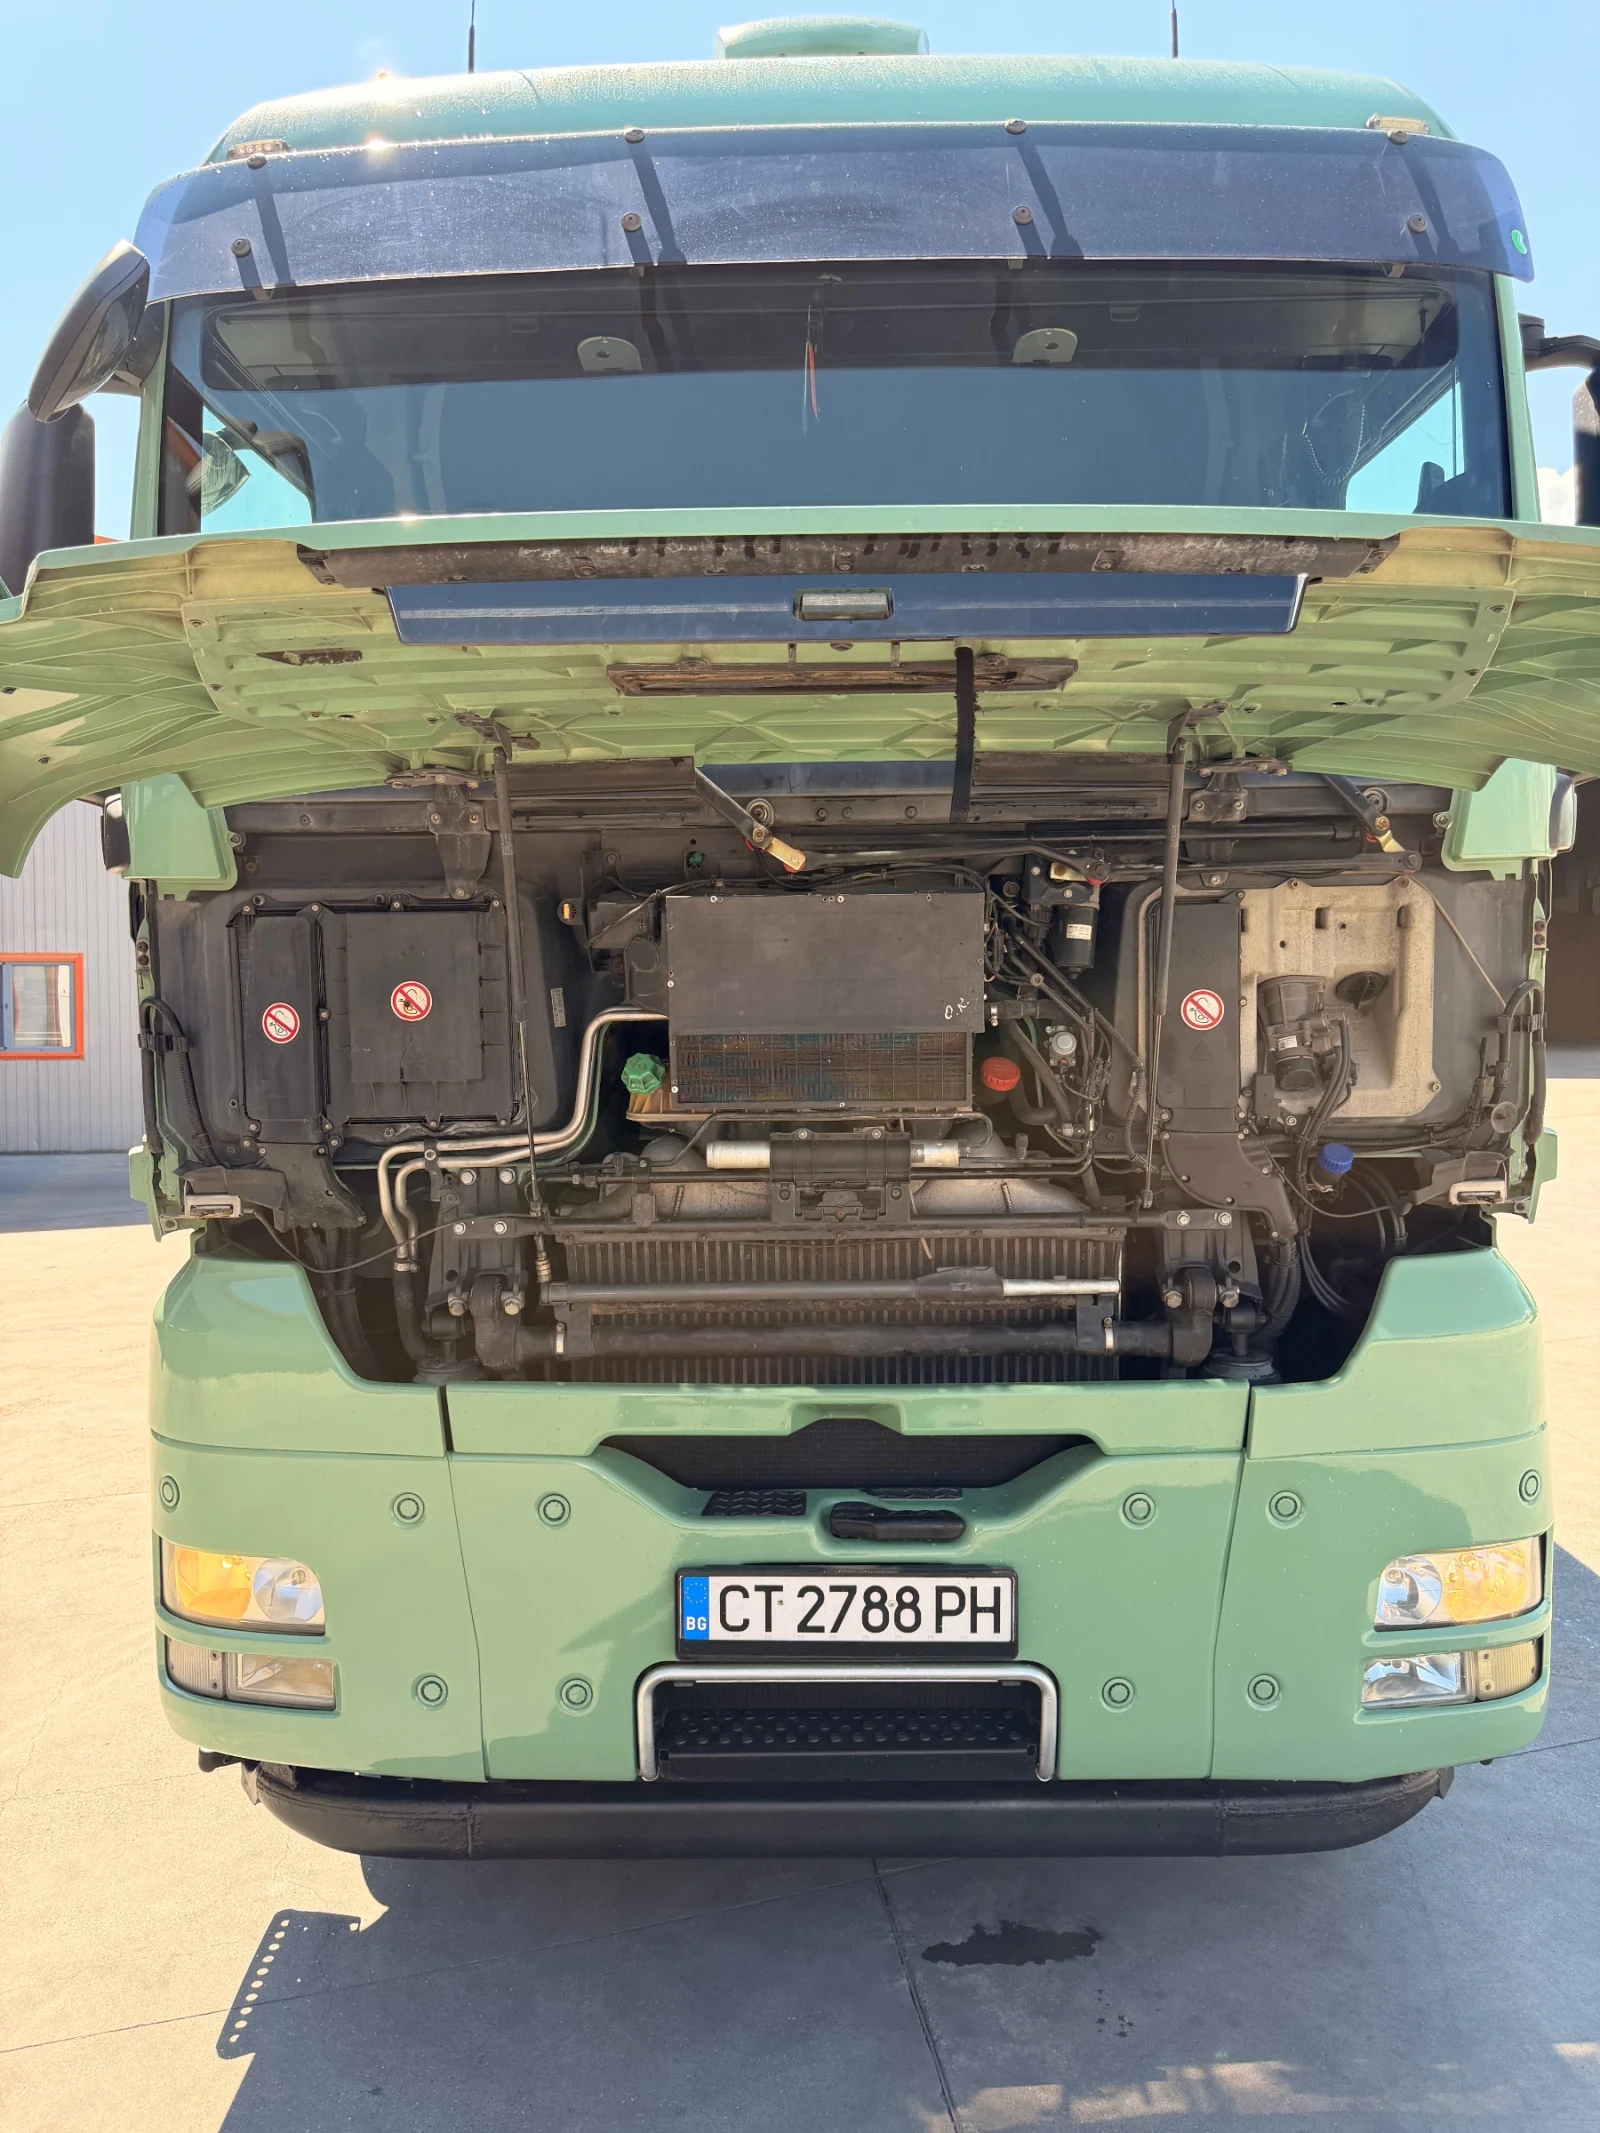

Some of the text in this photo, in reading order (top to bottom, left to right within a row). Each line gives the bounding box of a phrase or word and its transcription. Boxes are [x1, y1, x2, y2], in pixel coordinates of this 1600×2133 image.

[686, 1616, 707, 1631] BG
[719, 1585, 1001, 1634] CT 2788 PH
